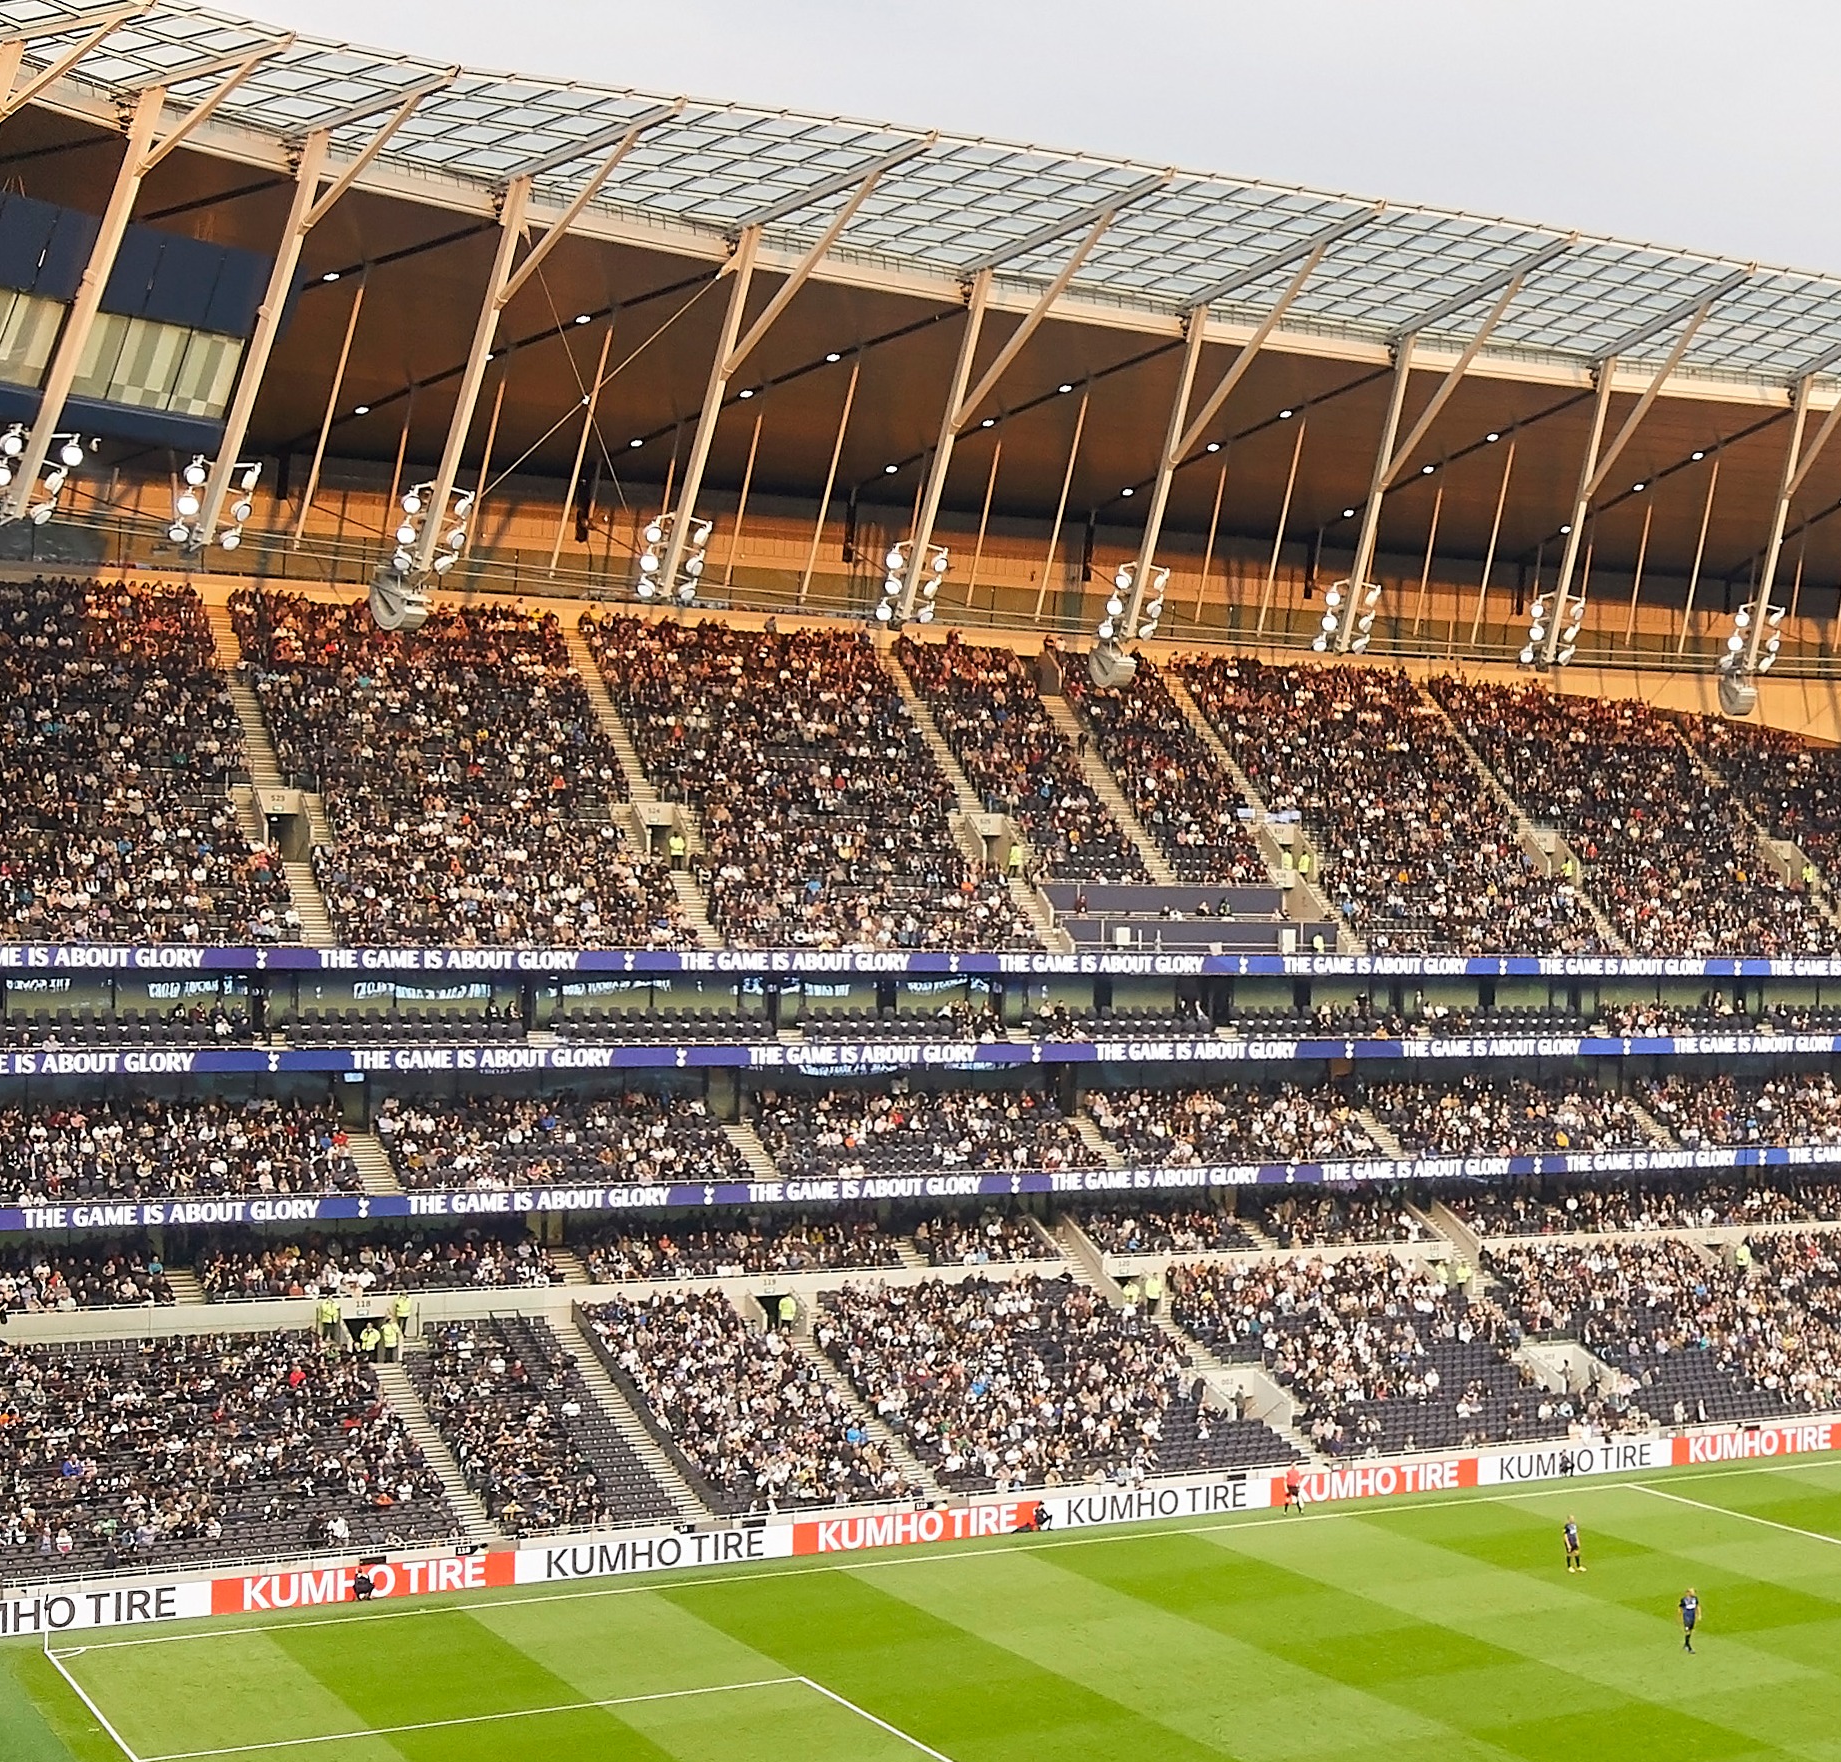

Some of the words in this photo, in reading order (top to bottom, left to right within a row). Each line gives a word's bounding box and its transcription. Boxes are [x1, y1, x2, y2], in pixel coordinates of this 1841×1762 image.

[28, 945, 49, 966] IS
[54, 946, 131, 967] ABOUT
[135, 946, 204, 967] GLORY
[15, 1054, 36, 1073] IS
[41, 1053, 119, 1073] ABOUT
[124, 1053, 194, 1072] GLORY
[22, 1208, 67, 1228] THE
[72, 1206, 137, 1227] GAME
[143, 1205, 164, 1224] IS
[169, 1202, 246, 1223] ABOUT
[250, 1200, 320, 1223] GLORY
[407, 1195, 447, 1214] THE
[452, 1193, 510, 1213] GAME
[514, 1192, 533, 1211] IS
[537, 1189, 605, 1210] ABOUT
[608, 1186, 670, 1207] GLORY
[355, 1299, 371, 1307] 118
[1601, 1443, 1651, 1472] TIRE
[1689, 1431, 1778, 1464] KUMHO
[1785, 1424, 1832, 1455] TIRE
[1296, 1466, 1398, 1504] KUMHO
[1405, 1460, 1459, 1494] TIRE
[1067, 1490, 1179, 1525] KUMHO
[1187, 1482, 1247, 1513] TIRE
[818, 1512, 944, 1552] KUMHO
[954, 1504, 1018, 1537] TIRE
[547, 1539, 682, 1579] KUMHO
[695, 1530, 764, 1562] TIRE
[409, 1556, 486, 1596] TIRE
[86, 1587, 176, 1628] TIRE
